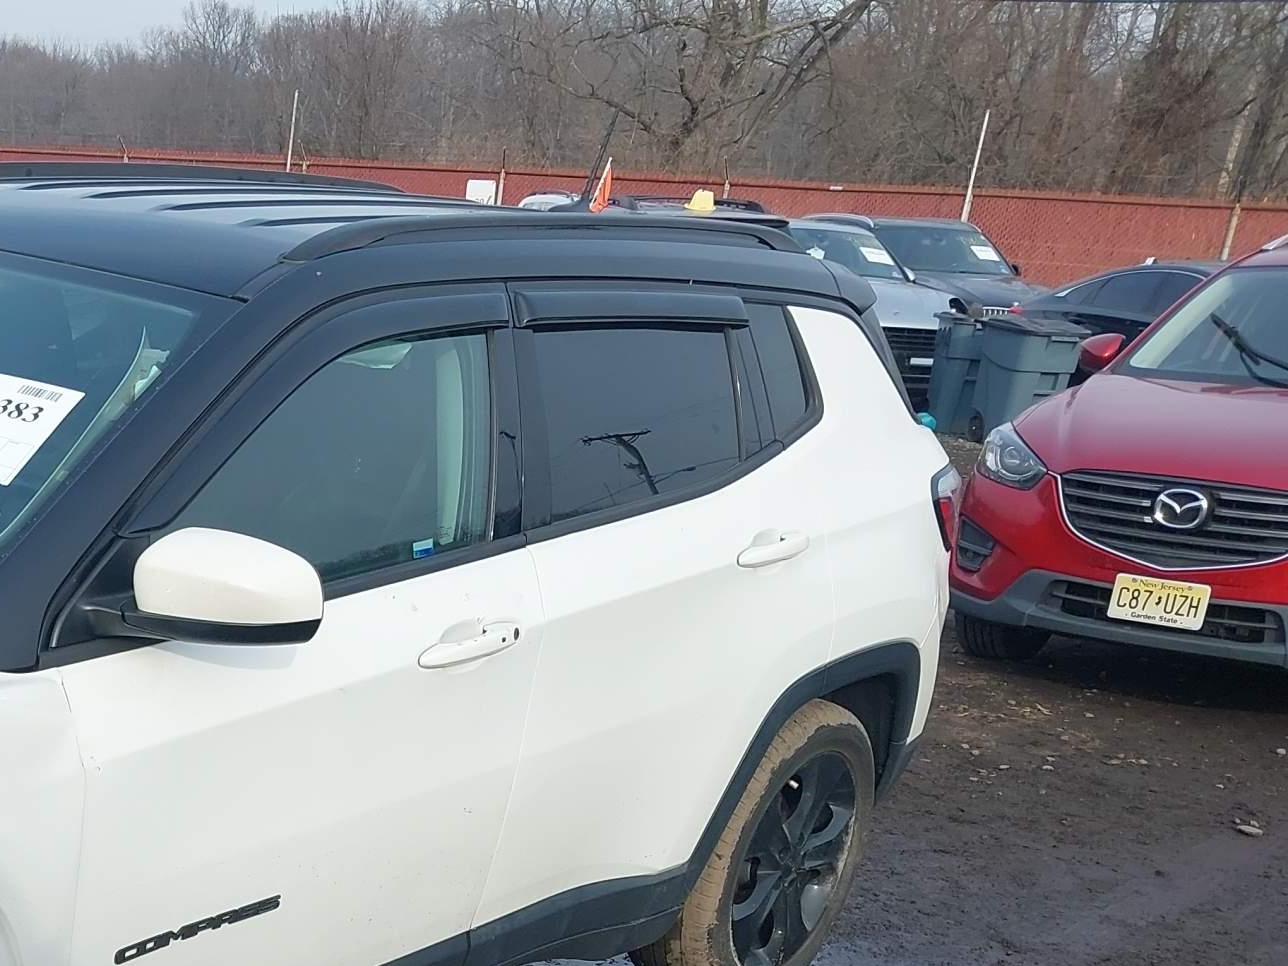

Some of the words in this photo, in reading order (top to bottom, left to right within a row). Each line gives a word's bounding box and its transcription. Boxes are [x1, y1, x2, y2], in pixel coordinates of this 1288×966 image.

[1138, 579, 1158, 589] New
[1158, 582, 1186, 593] Jersey
[1116, 586, 1154, 611] C87
[1163, 592, 1202, 618] UZH
[1130, 611, 1156, 621] Garden
[1158, 615, 1178, 624] State
